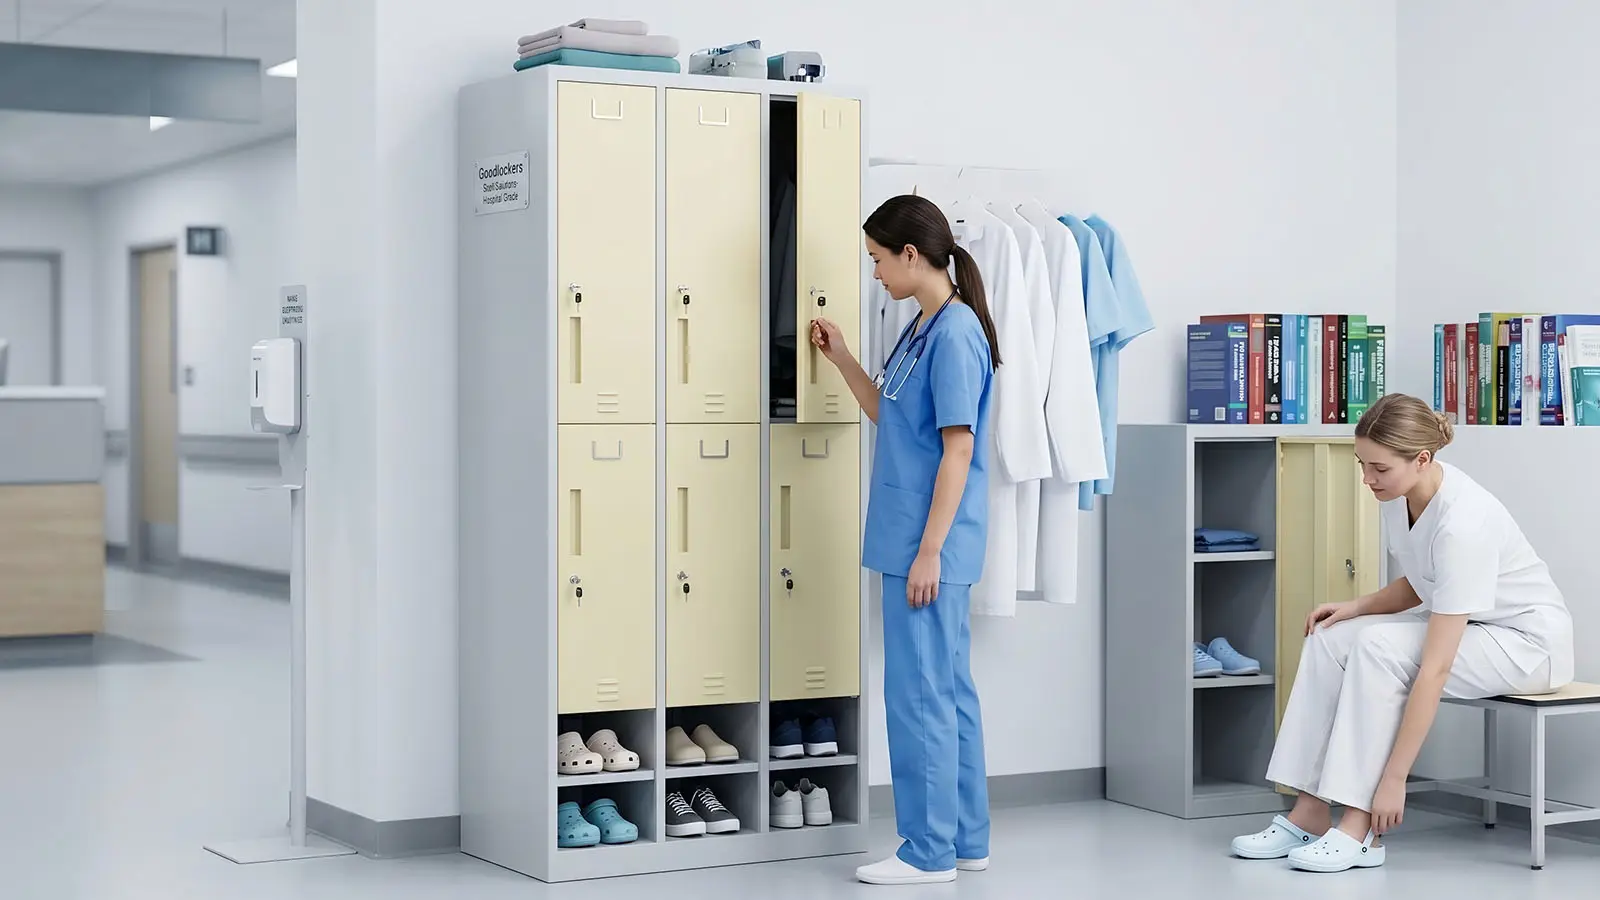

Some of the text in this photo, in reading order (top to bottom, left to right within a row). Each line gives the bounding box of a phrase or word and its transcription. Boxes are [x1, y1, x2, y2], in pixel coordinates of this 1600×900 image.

[479, 162, 523, 179] Goodlockers
[483, 192, 518, 205] Hospital Grade
